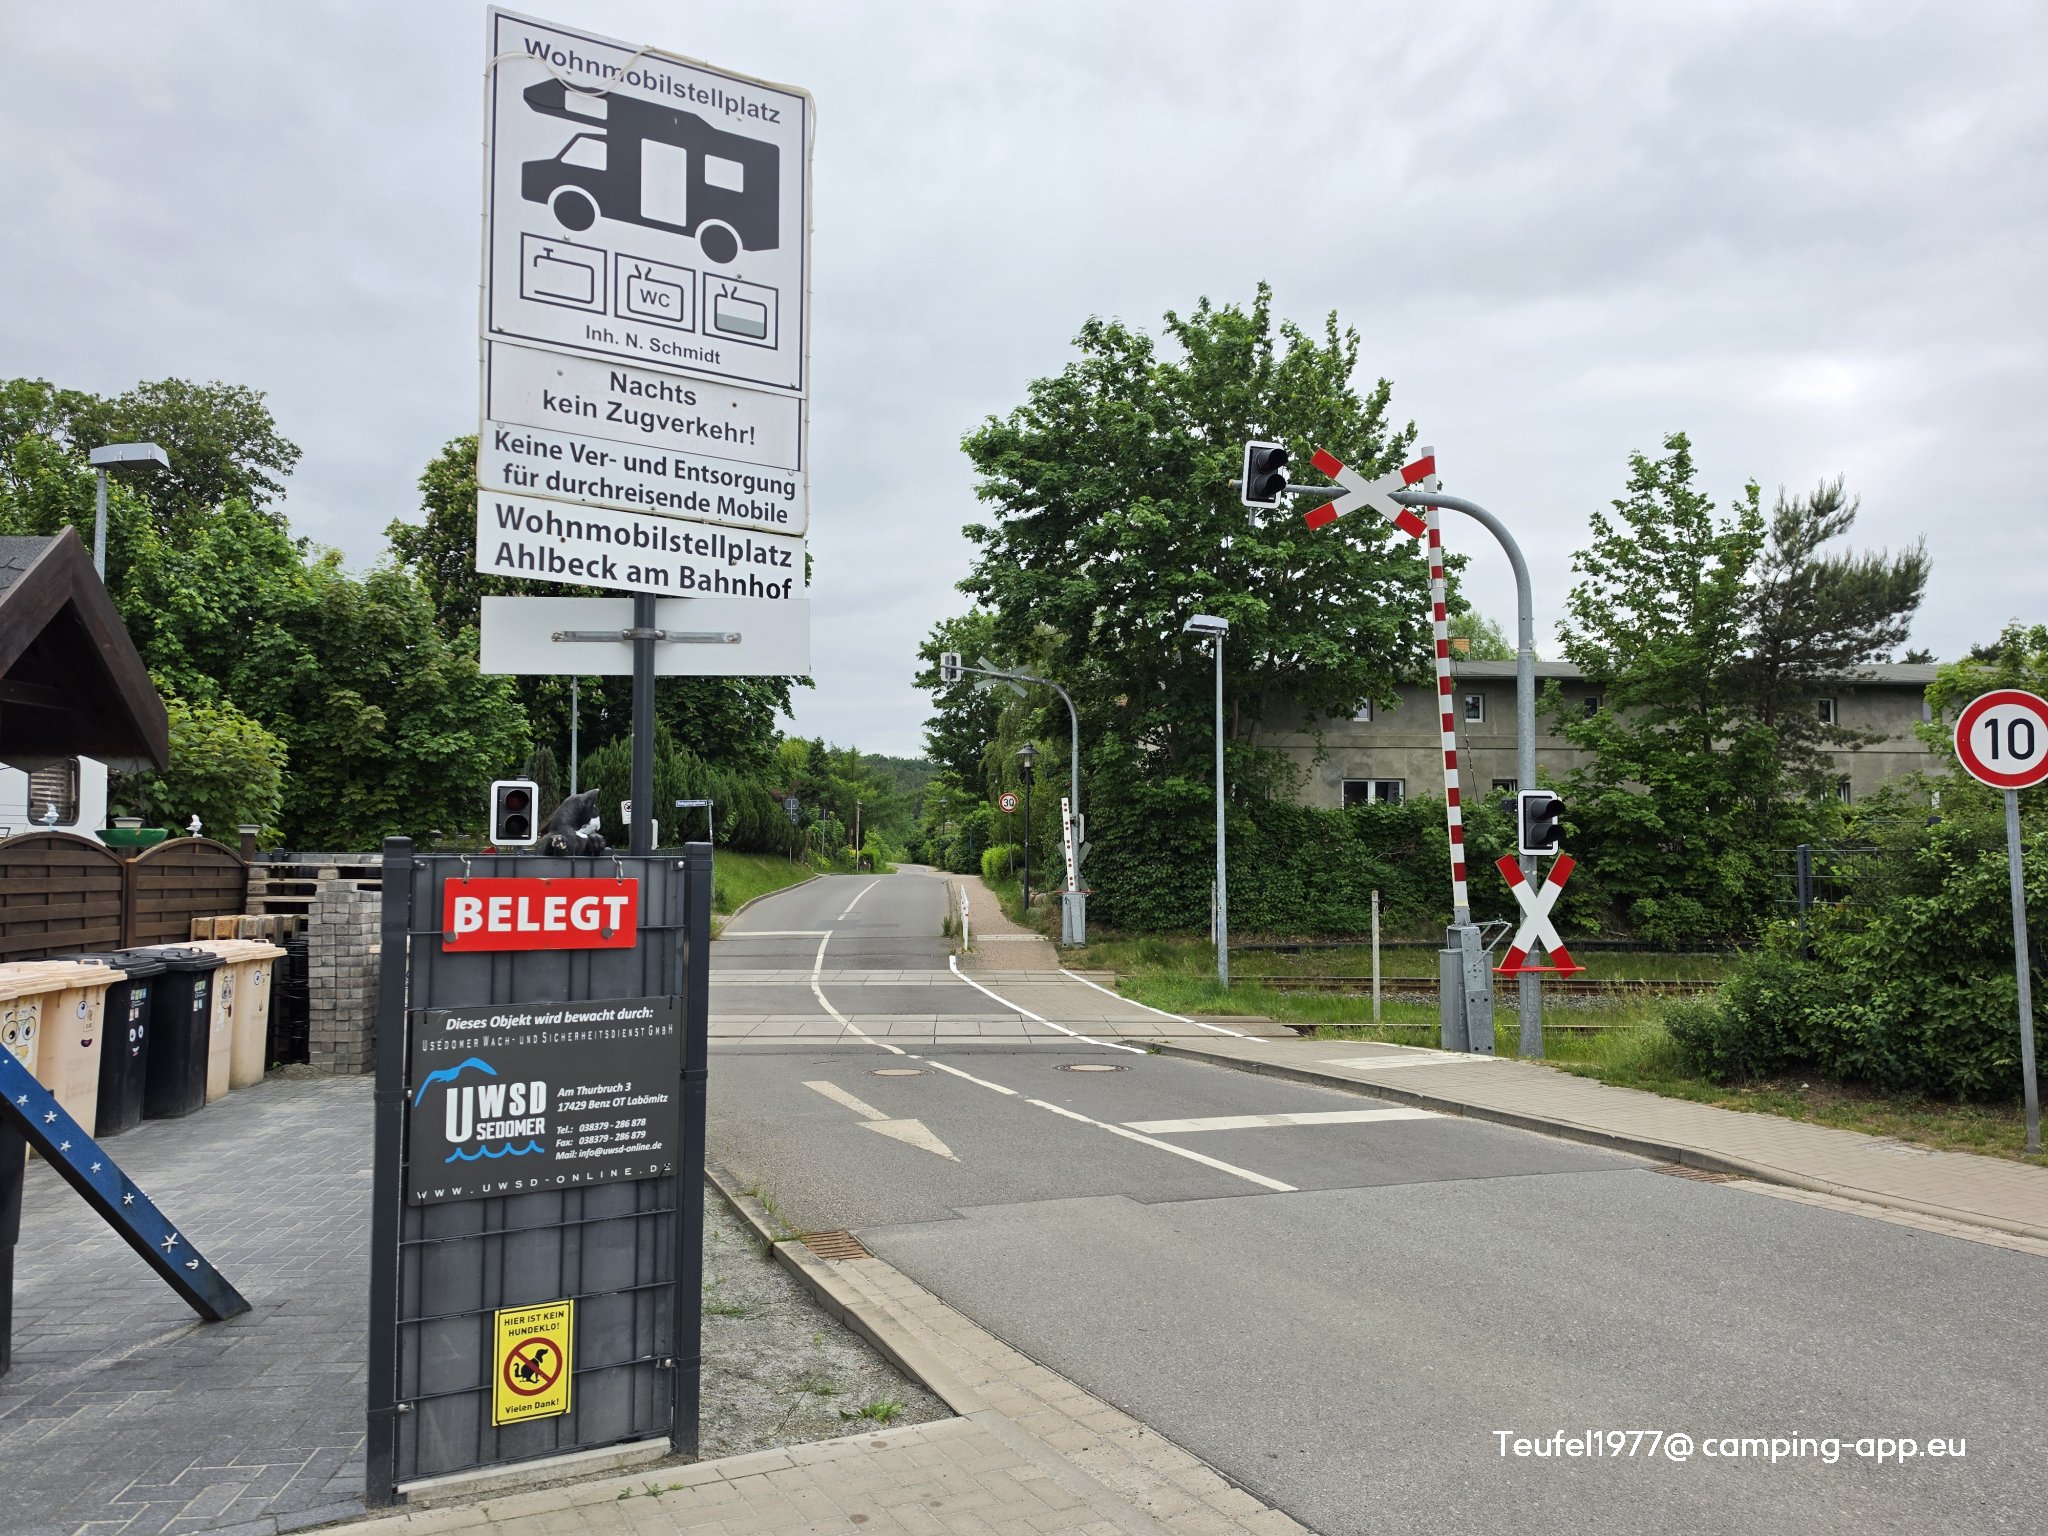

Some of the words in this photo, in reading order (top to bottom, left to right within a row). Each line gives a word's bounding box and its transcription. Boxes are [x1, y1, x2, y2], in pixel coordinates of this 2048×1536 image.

[524, 37, 781, 124] Wohnmobilstellplatz
[640, 288, 671, 308] WC
[586, 325, 619, 345] Inh.
[625, 333, 643, 349] N.
[649, 338, 721, 365] Schmidt
[610, 371, 697, 406] Nachts
[543, 389, 598, 418] kein
[606, 401, 756, 446] Zugverkehr!
[494, 430, 563, 460] Keine
[569, 442, 617, 467] Ver-
[624, 456, 667, 477] und
[674, 459, 796, 501] Entsorgung
[503, 463, 539, 488] für
[545, 470, 711, 513] durchreisende
[716, 495, 788, 524] Mobile
[495, 503, 792, 568] Wohnmobilstellplatz
[494, 542, 618, 581] Ahlbeck
[626, 566, 669, 587] am
[679, 565, 792, 600] Bahnhof
[1985, 718, 2035, 760] 10
[1004, 798, 1014, 807] 30
[454, 896, 629, 933] BELEGT
[446, 1018, 487, 1031] Dieses
[490, 1013, 532, 1029] Objekt
[535, 1011, 562, 1025] wird
[564, 1009, 614, 1023] bewacht
[617, 1006, 654, 1020] durch:
[557, 1087, 574, 1097] Am
[577, 1083, 623, 1096] Thurbruch
[625, 1082, 632, 1092] 3
[557, 1101, 587, 1112] 17429
[588, 1099, 611, 1110] Benz
[612, 1097, 627, 1107] OT
[627, 1094, 669, 1106] Labömitz
[556, 1125, 574, 1134] Tel.:
[579, 1121, 610, 1132] 038379
[615, 1120, 631, 1129] 286
[632, 1118, 647, 1127] 878
[556, 1138, 574, 1147] Fax:
[579, 1134, 610, 1145] 038379
[615, 1132, 631, 1142] 286
[632, 1130, 647, 1140] 879
[555, 1150, 578, 1160] Mail:
[579, 1141, 663, 1158] info@uwsd-online.de
[504, 1316, 525, 1326] HIER
[527, 1314, 541, 1322] IST
[543, 1310, 564, 1320] KEIN
[508, 1323, 560, 1337] HUNDEKLO!
[505, 1404, 532, 1414] Vielen
[534, 1398, 559, 1409] Dank!
